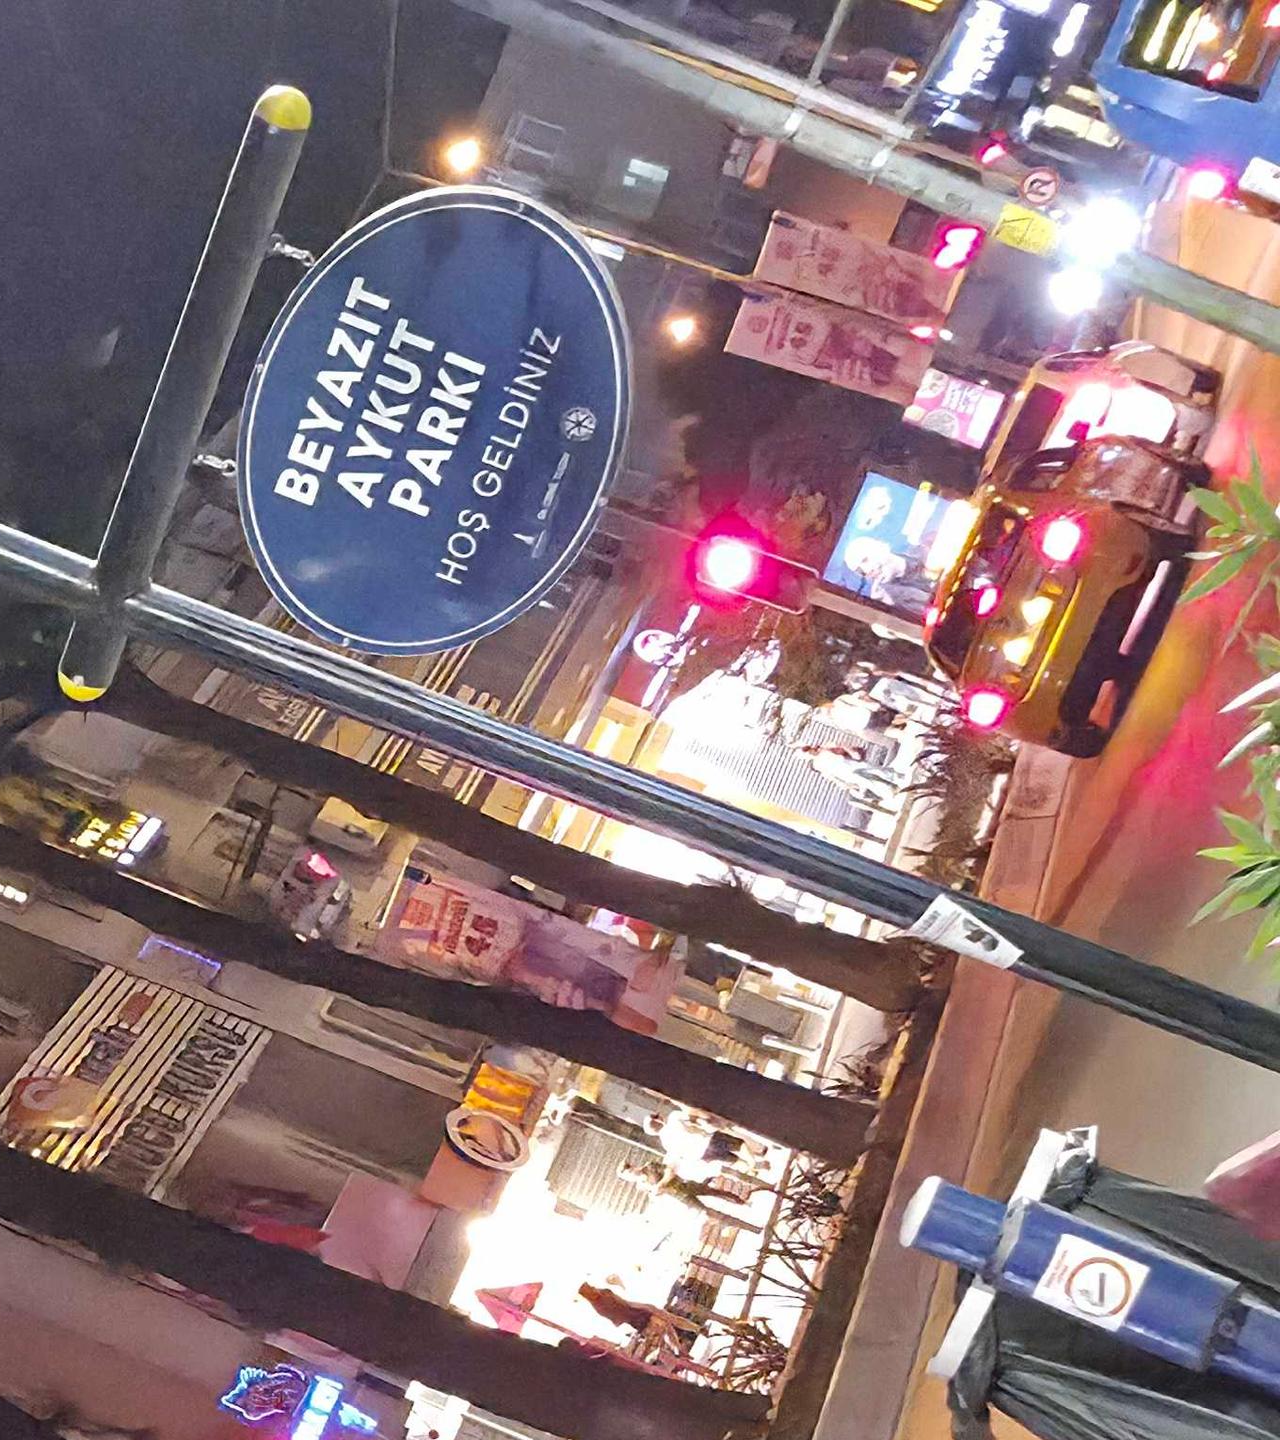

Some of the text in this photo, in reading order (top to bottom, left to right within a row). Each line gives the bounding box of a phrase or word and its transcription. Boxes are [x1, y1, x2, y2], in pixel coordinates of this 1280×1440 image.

[275, 275, 395, 506] BEYAZIT
[337, 316, 436, 508] AYKUT
[387, 349, 487, 517] PARKI
[435, 506, 488, 584] HOŞ
[473, 325, 561, 496] GELDİNİZ
